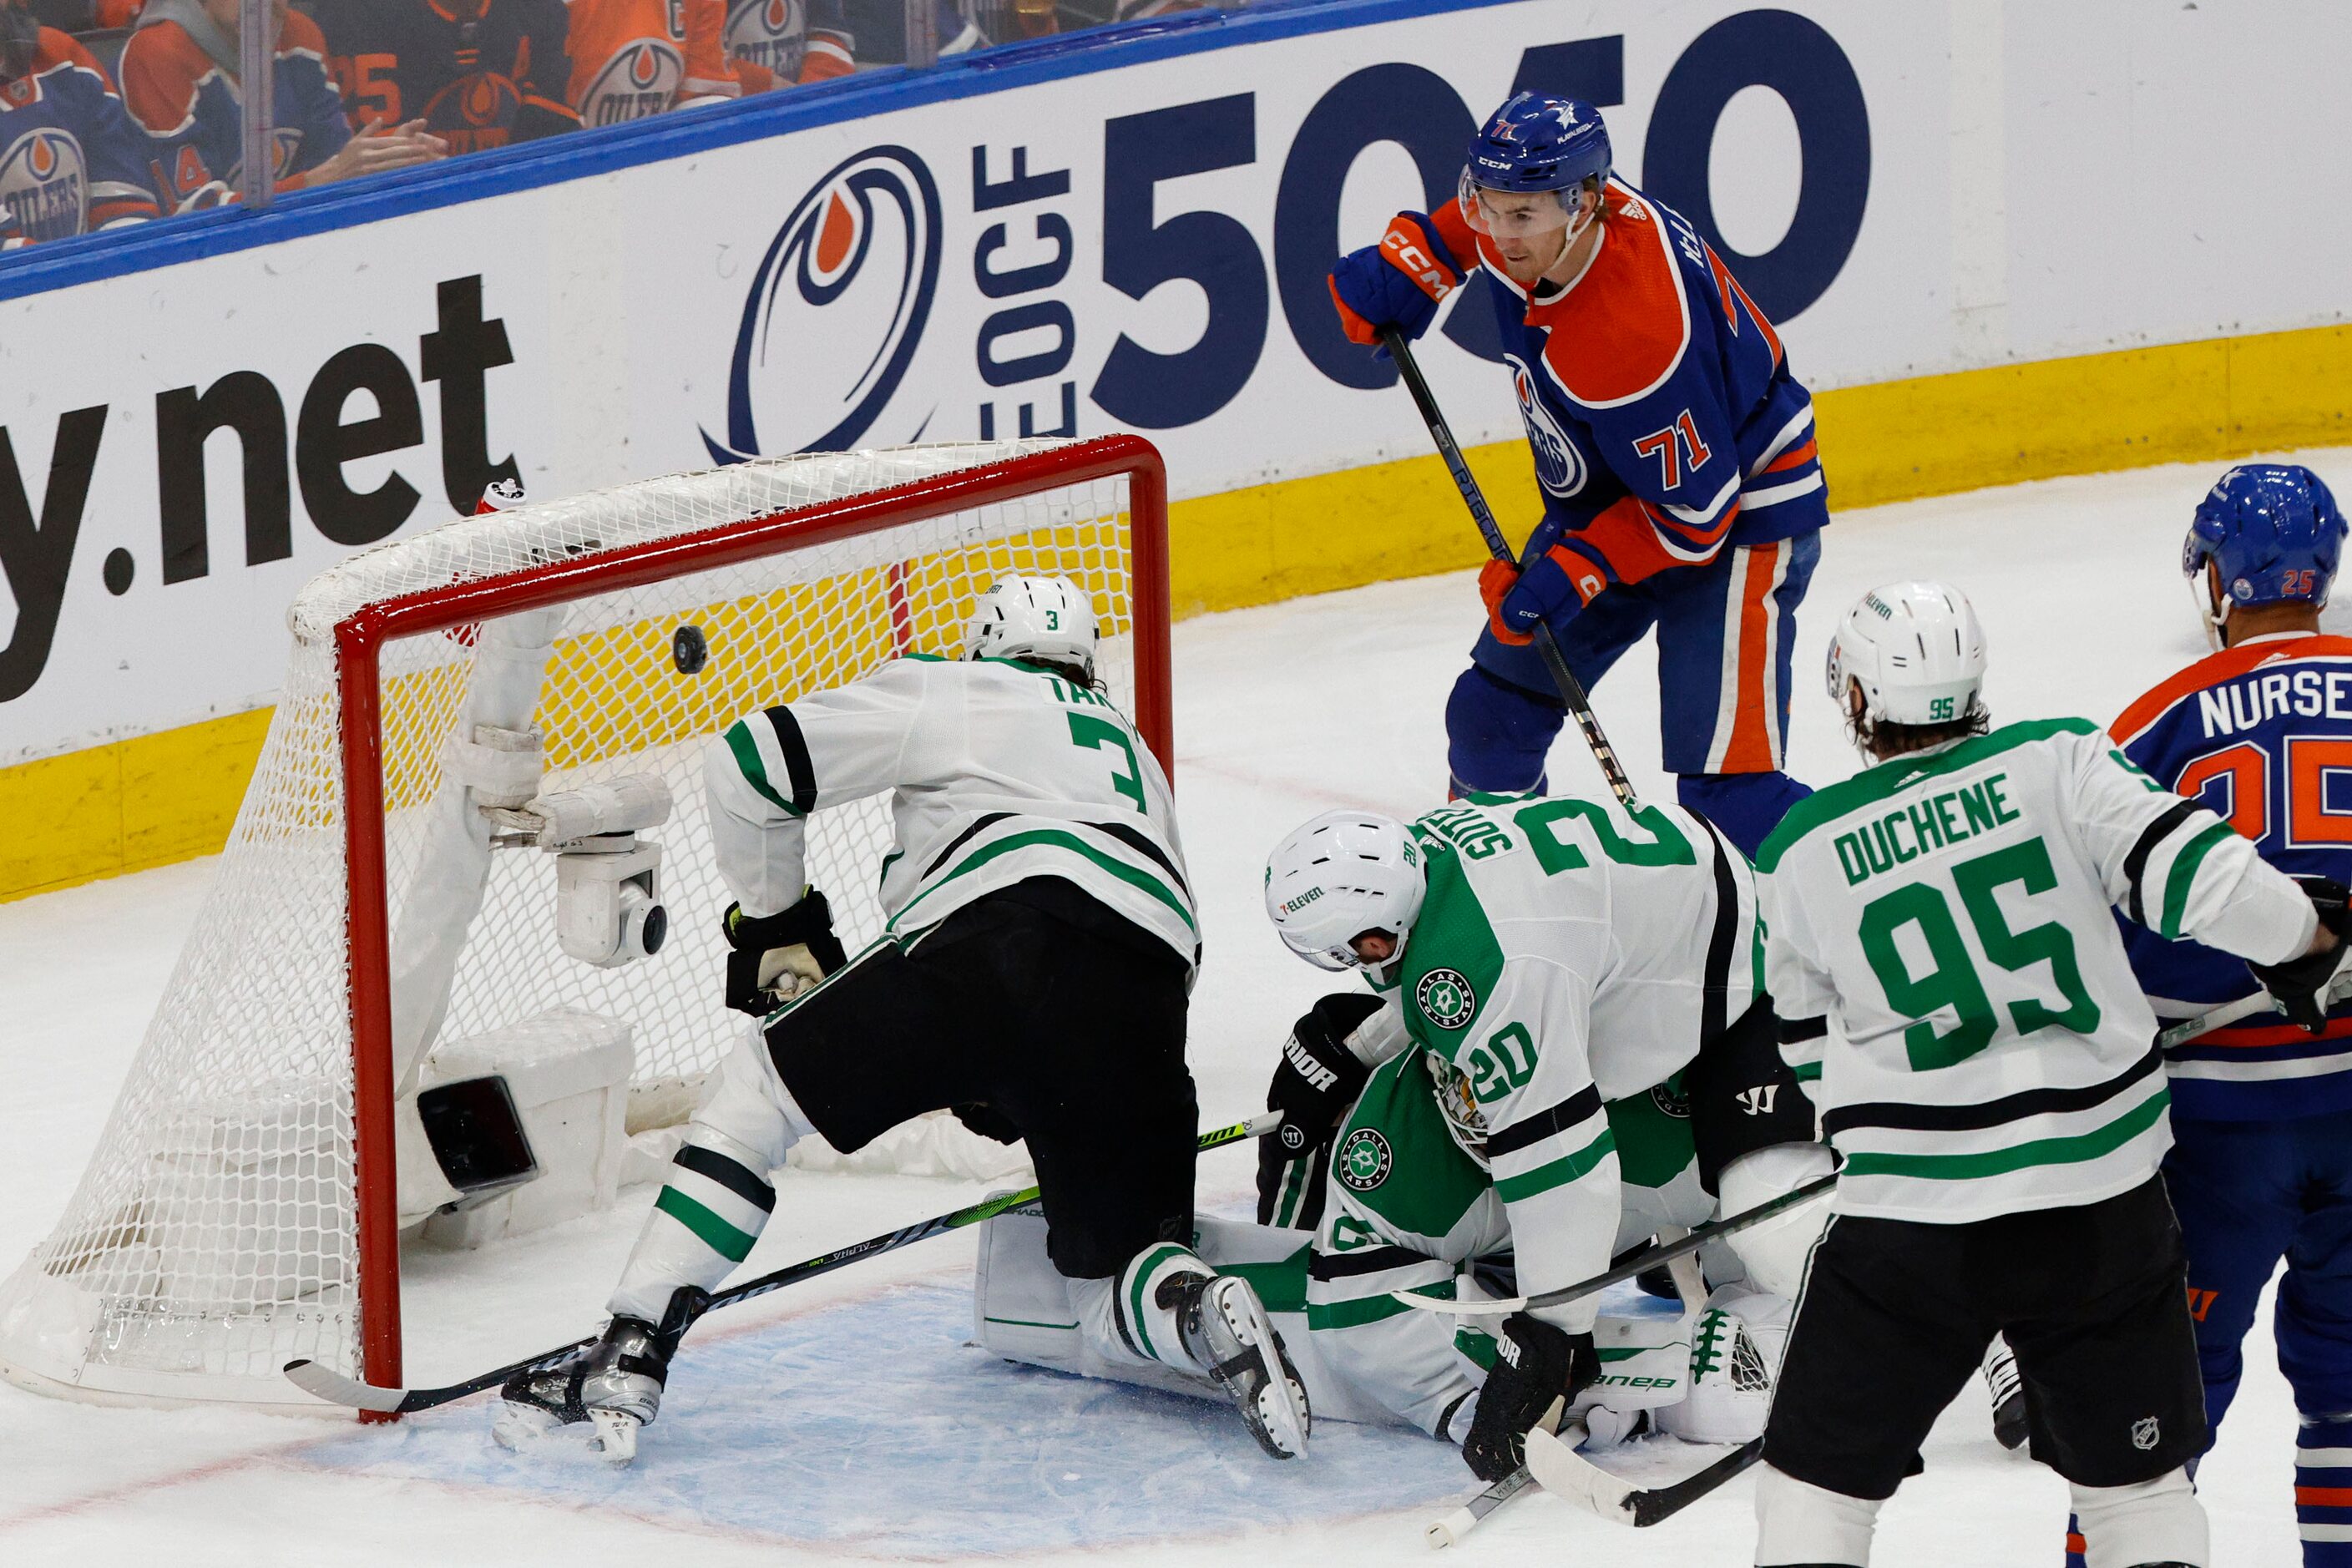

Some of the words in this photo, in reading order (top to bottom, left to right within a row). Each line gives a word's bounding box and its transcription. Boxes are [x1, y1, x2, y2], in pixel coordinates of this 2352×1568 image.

[1491, 119, 1518, 142] 71
[1479, 156, 1513, 170] CCM
[1382, 230, 1450, 299] CCM
[1631, 408, 1712, 492] 71
[2281, 569, 2316, 594] 25
[1046, 611, 1059, 631] 3
[1930, 697, 1954, 721] 95
[2198, 670, 2352, 739] NURSE
[1067, 711, 1147, 817] 3
[1834, 772, 2021, 887] DUCHENE
[1858, 836, 2101, 1072] 95
[1419, 973, 1456, 1014] DALLAS
[1443, 989, 1472, 1026] STARS
[1469, 1021, 1538, 1104] 20
[1342, 1154, 1373, 1186] STARS
[1352, 1132, 1388, 1171] DALLAS
[832, 1242, 871, 1261] ALPHA
